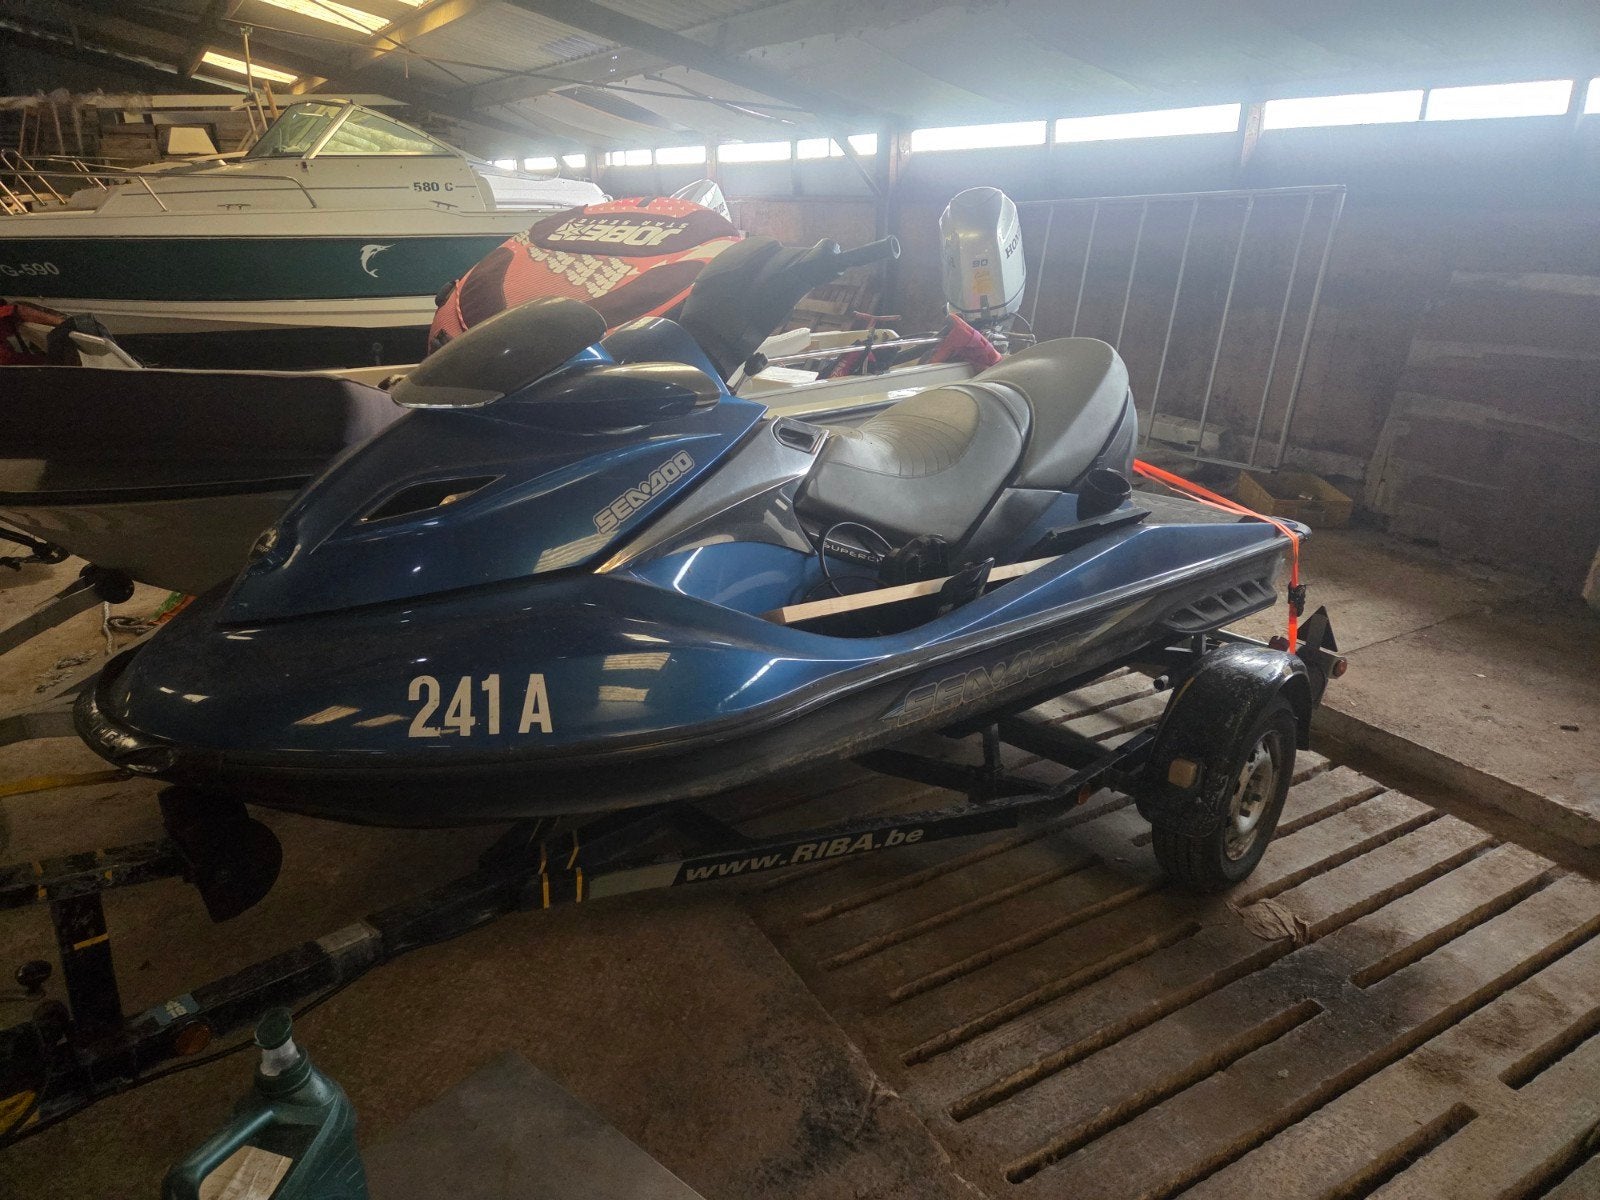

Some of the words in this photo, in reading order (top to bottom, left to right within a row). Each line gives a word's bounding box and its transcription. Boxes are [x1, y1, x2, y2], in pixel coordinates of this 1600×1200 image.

[413, 181, 440, 192] 580
[642, 220, 689, 229] STAR
[408, 674, 500, 738] 241
[518, 673, 553, 733] A
[686, 828, 925, 881] www.RIBA.be
